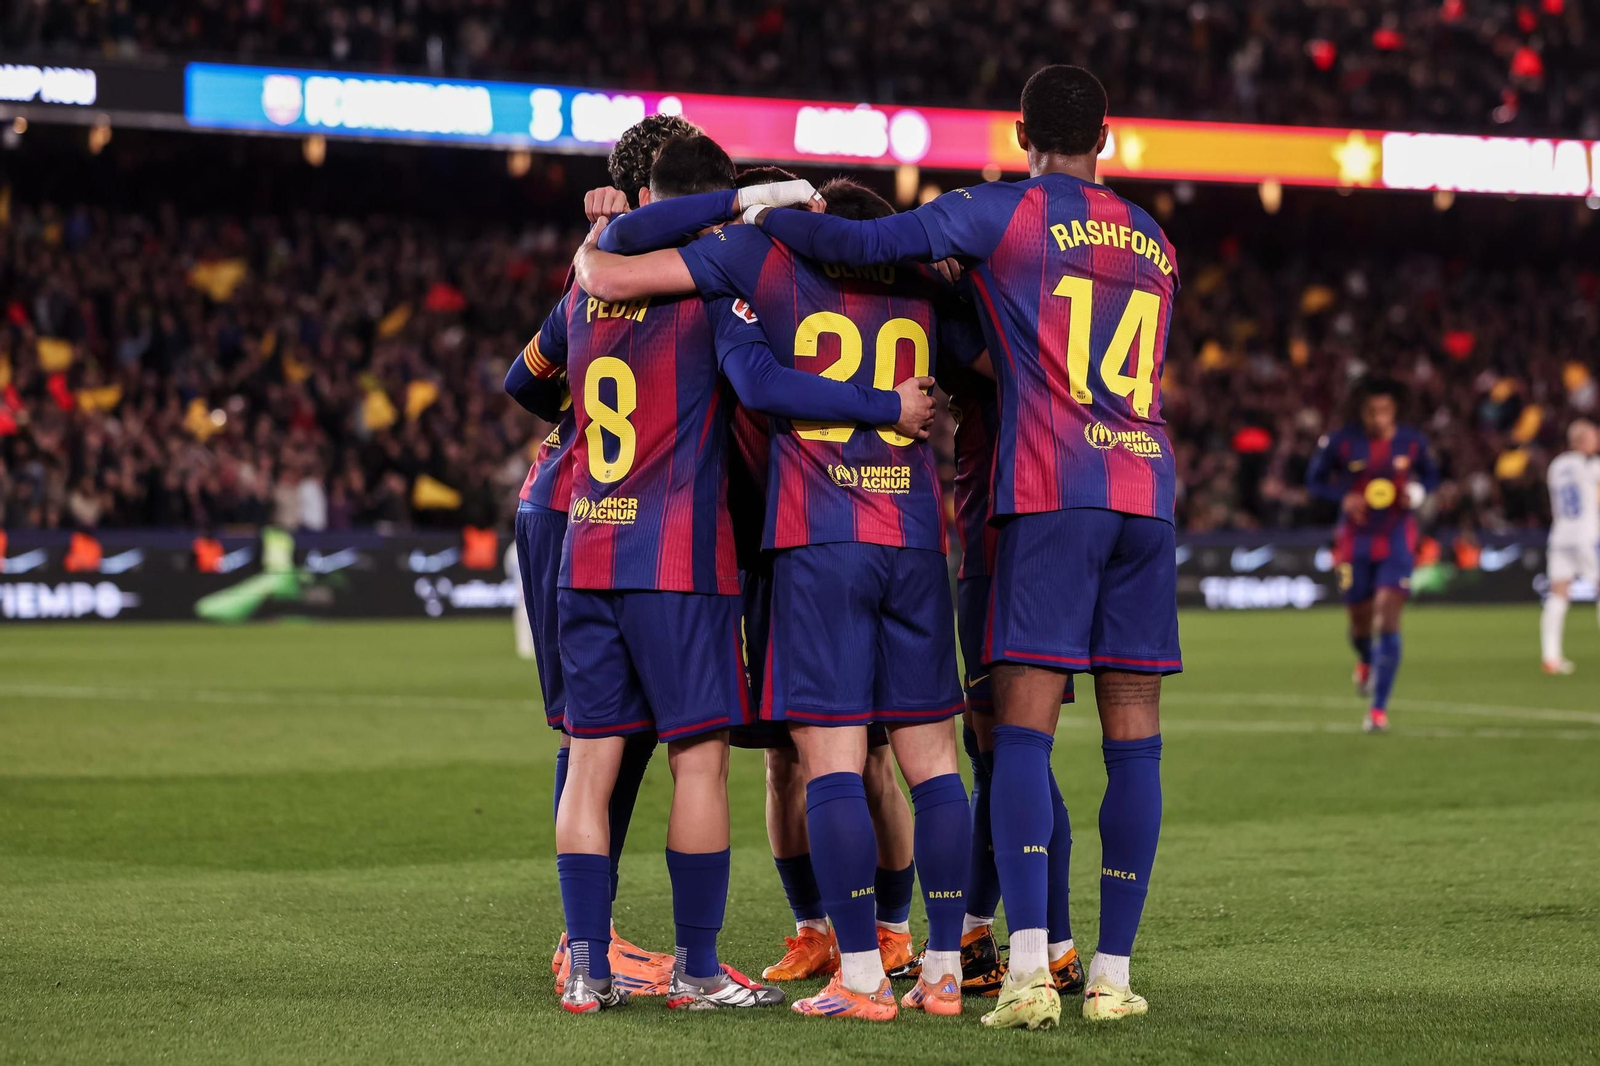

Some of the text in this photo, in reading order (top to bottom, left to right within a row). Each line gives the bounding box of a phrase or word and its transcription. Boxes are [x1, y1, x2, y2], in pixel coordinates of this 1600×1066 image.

[1050, 219, 1173, 276] RASHFORD
[1052, 275, 1161, 419] 14
[793, 311, 930, 447] 20
[584, 356, 637, 483] 8
[1122, 442, 1161, 453] CNUR
[860, 466, 911, 477] UNHCR
[861, 478, 910, 489] ACNUR
[592, 497, 639, 509] NHCR
[588, 508, 637, 520] ACNUR
